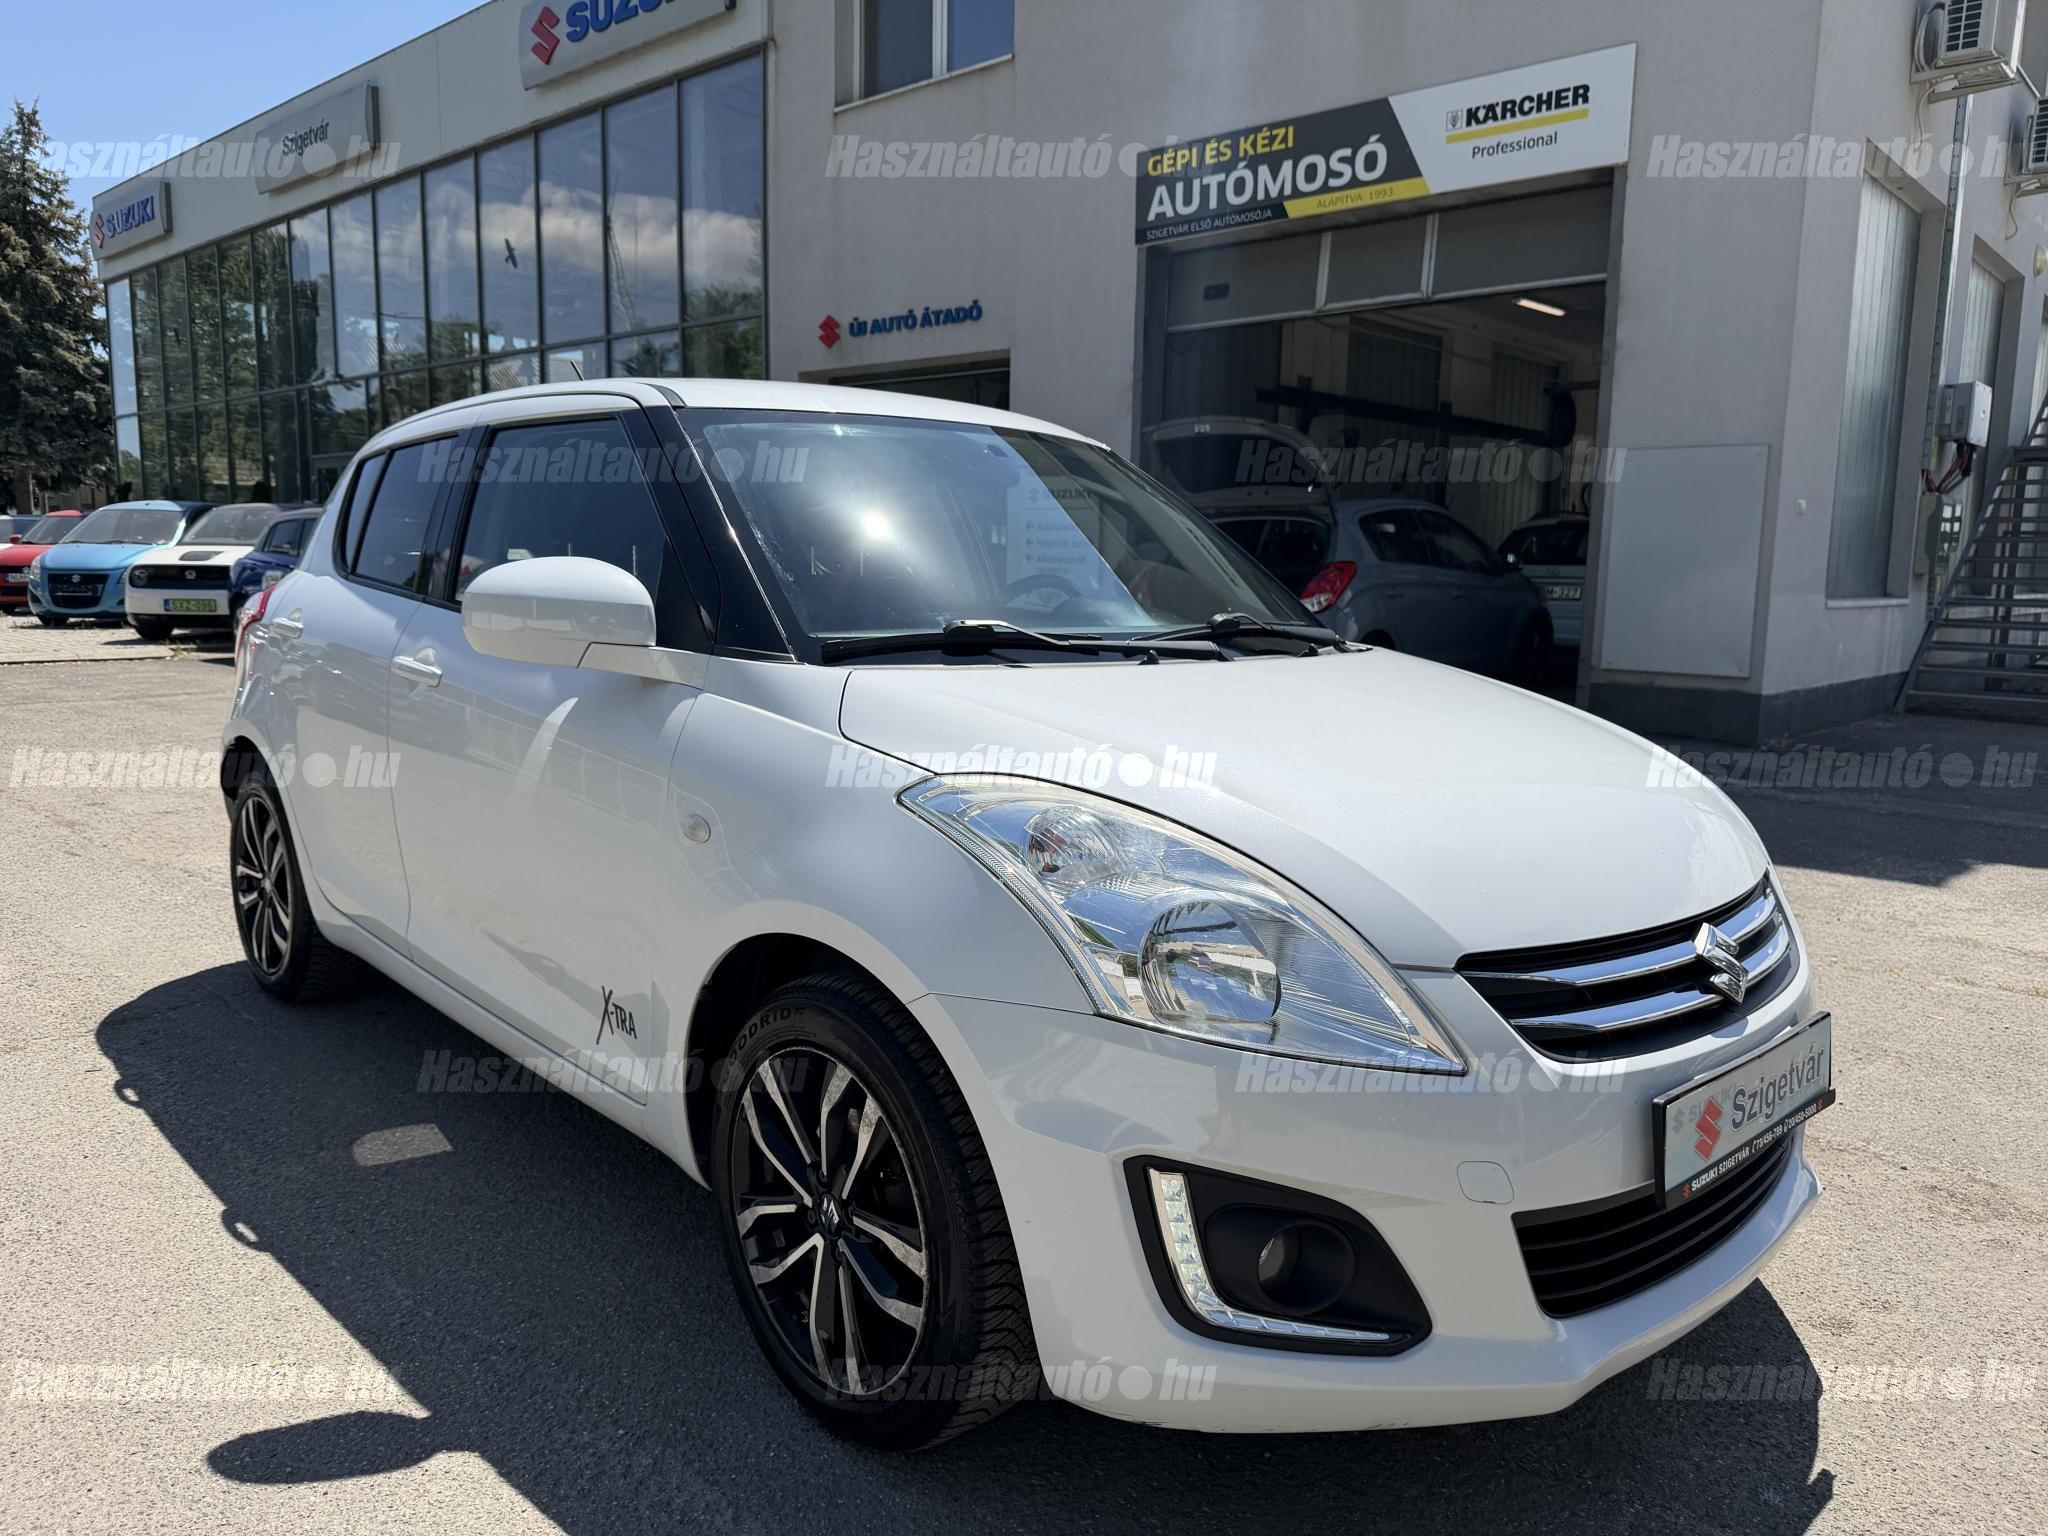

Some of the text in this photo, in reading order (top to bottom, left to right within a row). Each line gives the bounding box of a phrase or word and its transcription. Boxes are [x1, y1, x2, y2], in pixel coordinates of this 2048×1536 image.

[566, 0, 676, 42] SUZ
[1465, 84, 1590, 127] KÄRCHER
[282, 119, 330, 158] Szigetvár
[1147, 125, 1294, 177] GÉPI ÉS KÉZI
[1472, 131, 1558, 159] Professional
[1147, 134, 1388, 222] AUTÓMOSÓ
[1368, 187, 1394, 203] 1993
[105, 196, 155, 239] SUZUKI
[869, 309, 918, 335] AUTÓ
[920, 299, 983, 329] ÁTADÓ
[596, 985, 637, 1046] X-TRA
[1731, 1044, 1825, 1131] Szigetvár
[1691, 1165, 1718, 1191] SUZUKI
[1718, 1146, 1750, 1175] SZIGETVÁR
